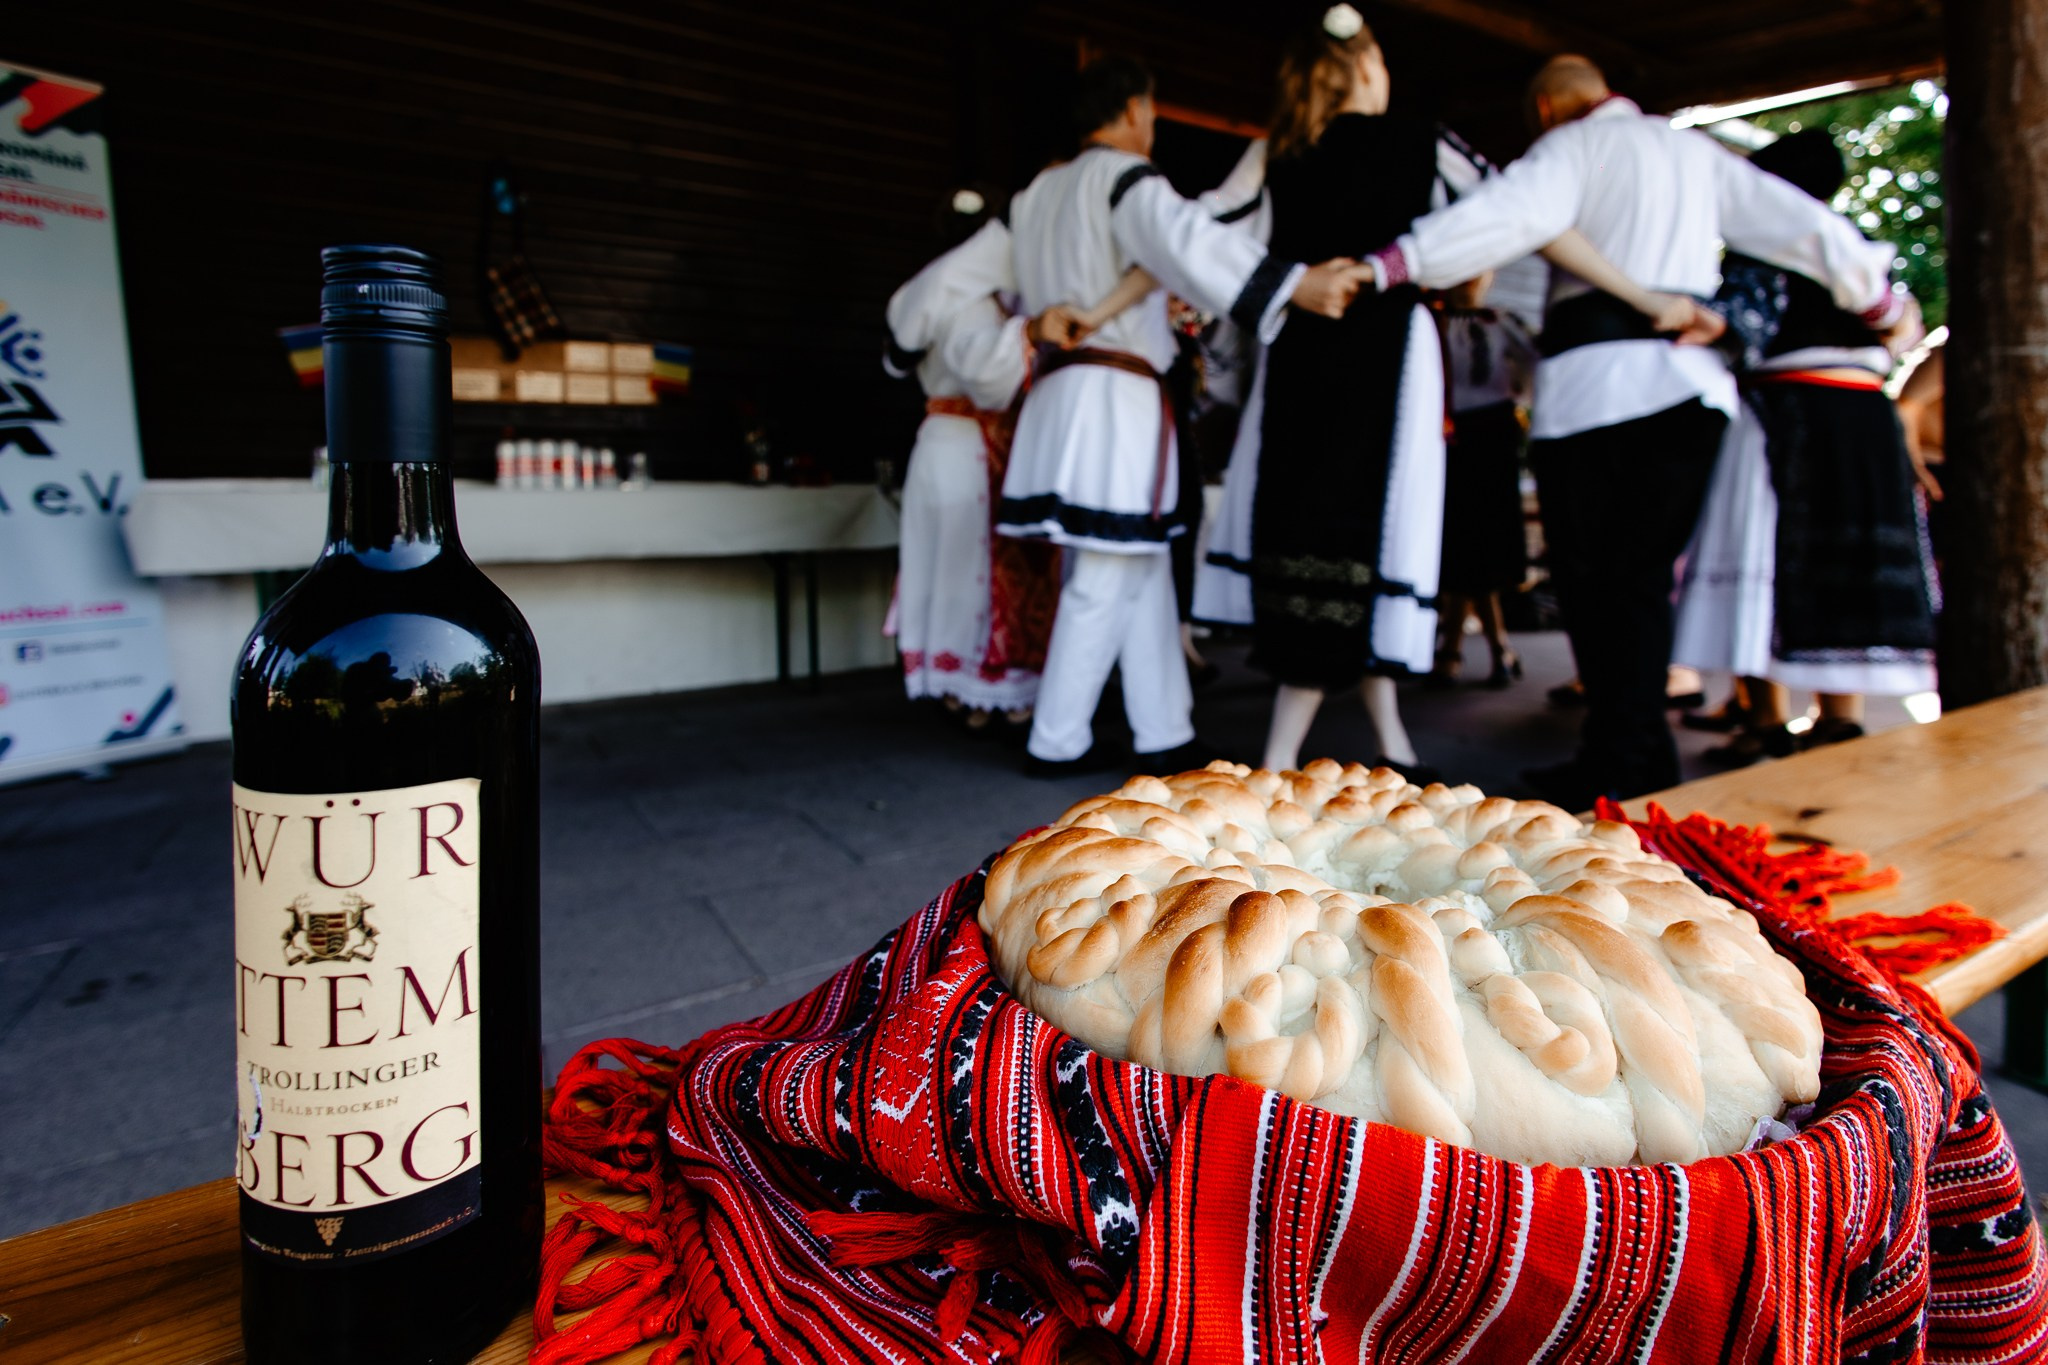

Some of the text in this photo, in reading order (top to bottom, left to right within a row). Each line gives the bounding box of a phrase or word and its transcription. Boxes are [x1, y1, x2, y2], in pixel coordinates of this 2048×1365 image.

[234, 798, 477, 889] WÜR
[236, 945, 479, 1049] TTEM
[247, 1051, 442, 1092] TROLLINGER
[236, 1100, 479, 1207] BERG
